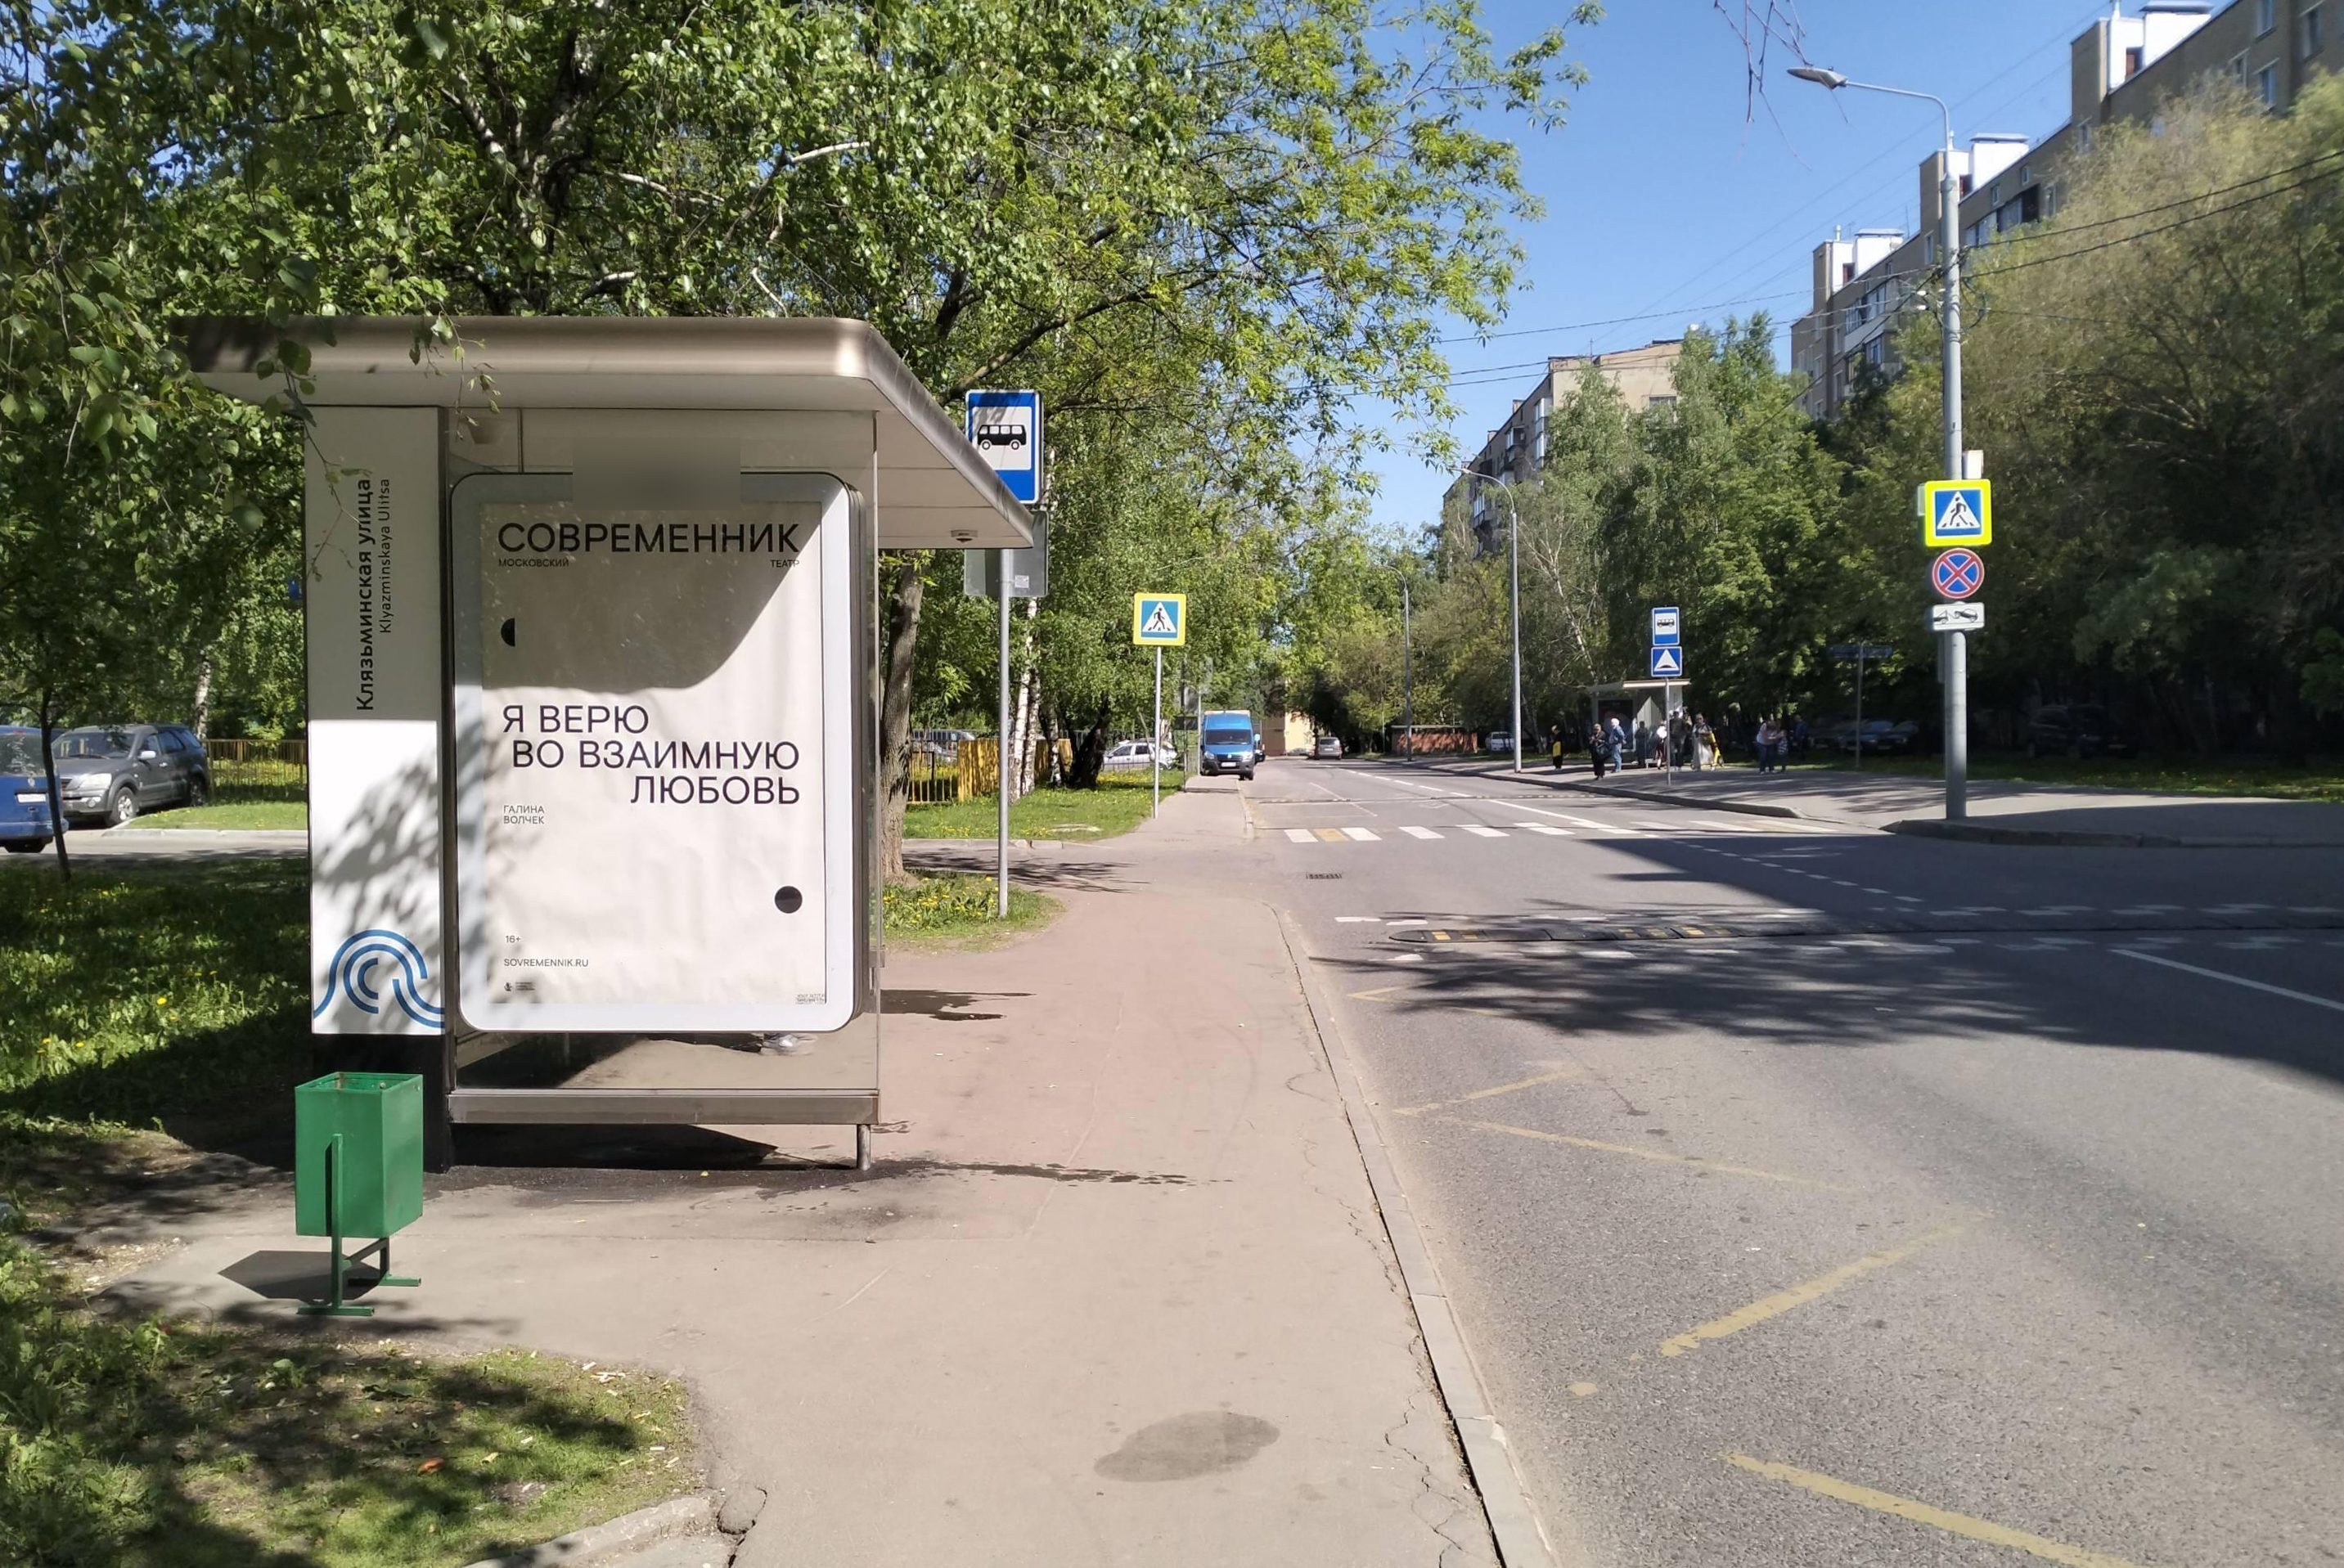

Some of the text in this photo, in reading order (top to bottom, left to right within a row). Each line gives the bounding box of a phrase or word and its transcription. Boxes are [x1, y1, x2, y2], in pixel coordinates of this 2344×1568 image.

[497, 522, 799, 553] СОВРЕМЕННИК
[378, 478, 393, 633] Klyazminskaya Ulitsa
[498, 557, 800, 568] МОСКОВСКИЙ ТЕАТР
[356, 479, 376, 711] Клязьминская улица
[503, 705, 650, 734] Я ВЕРЮ
[512, 740, 799, 770] ВО ВЗАИМНУЮ
[630, 776, 800, 804] ЛЮБОВЬ
[503, 805, 544, 813] ГАЛИНА
[503, 815, 544, 824] ВОЛЧЕК
[505, 935, 521, 943] 16+
[503, 958, 589, 967] SOVREMENNIK.RU
